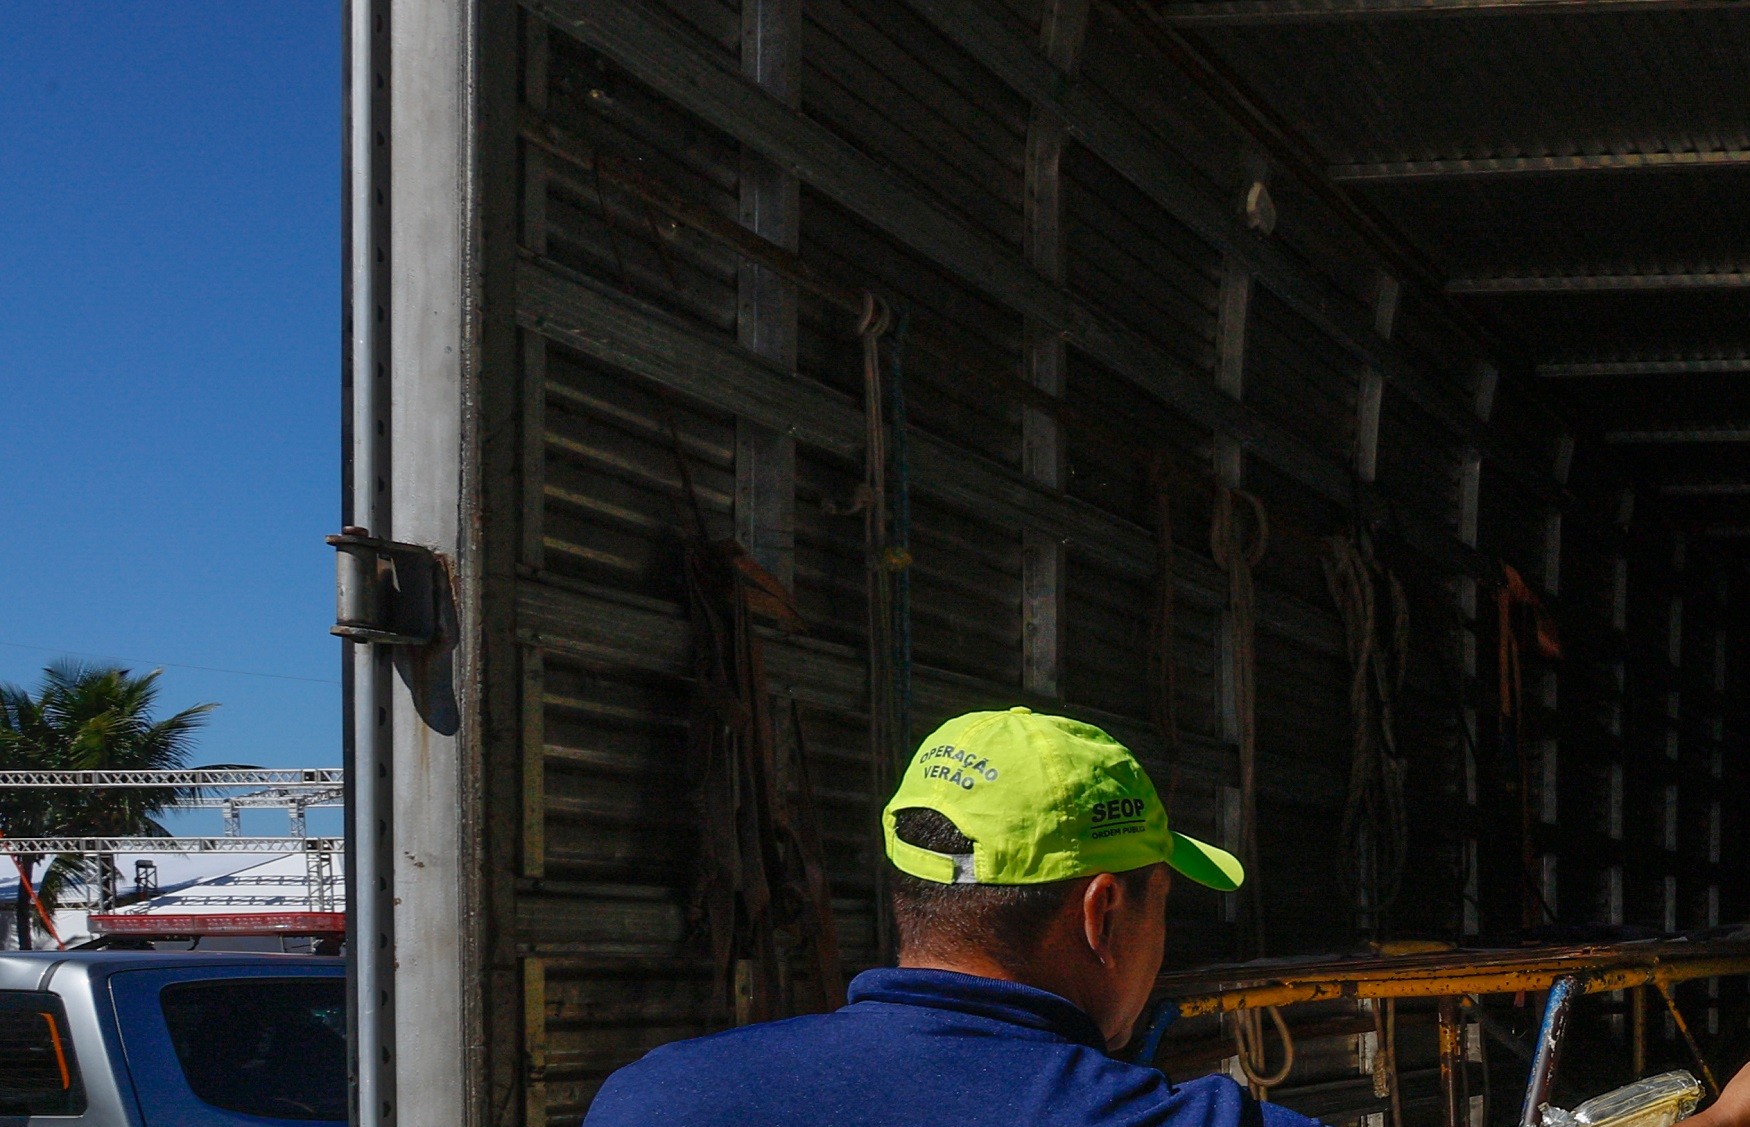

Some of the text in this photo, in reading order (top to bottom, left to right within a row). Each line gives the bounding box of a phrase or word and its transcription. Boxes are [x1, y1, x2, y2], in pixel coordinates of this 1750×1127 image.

[919, 745, 998, 782] OPERAÇÃO
[924, 765, 974, 790] VERÃO
[1091, 798, 1145, 822] SEOP
[1092, 828, 1121, 839] ORDEM
